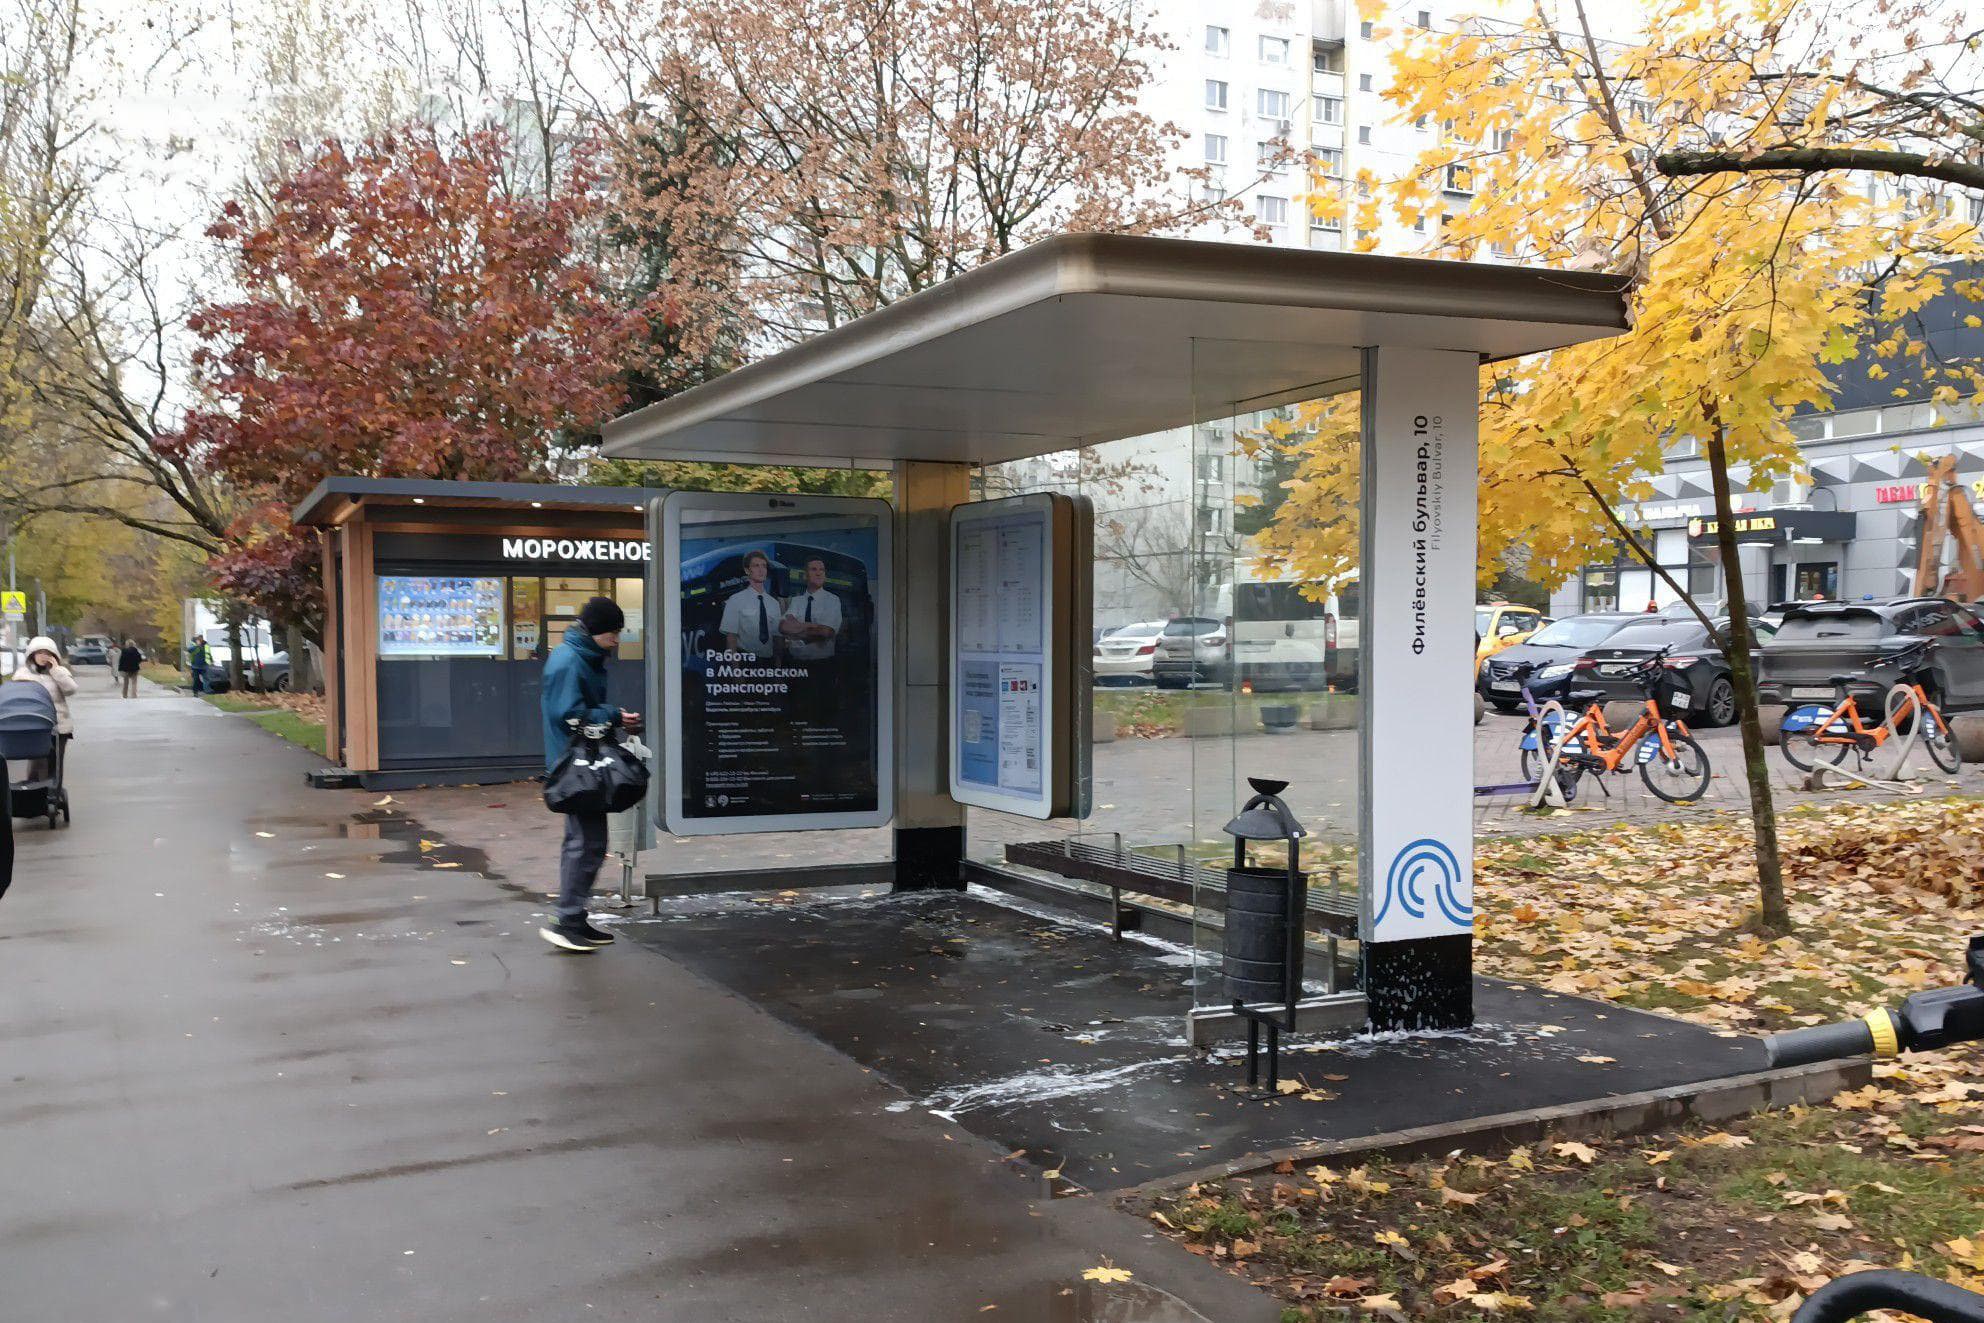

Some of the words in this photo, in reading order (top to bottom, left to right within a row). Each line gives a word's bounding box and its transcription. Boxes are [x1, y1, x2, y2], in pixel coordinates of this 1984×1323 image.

[1414, 415, 1428, 436] 10
[1433, 415, 1443, 429] 10
[1432, 432, 1444, 480] Bulvar,
[1413, 442, 1430, 532] бульвар,
[1431, 484, 1443, 550] Filyovskiy
[502, 538, 651, 561] МОРОЖЕНОЕ
[1412, 540, 1426, 654] Филёвский
[706, 649, 755, 662] Работа
[706, 668, 715, 678] в
[717, 665, 809, 678] Московском
[706, 683, 788, 696] транспорте
